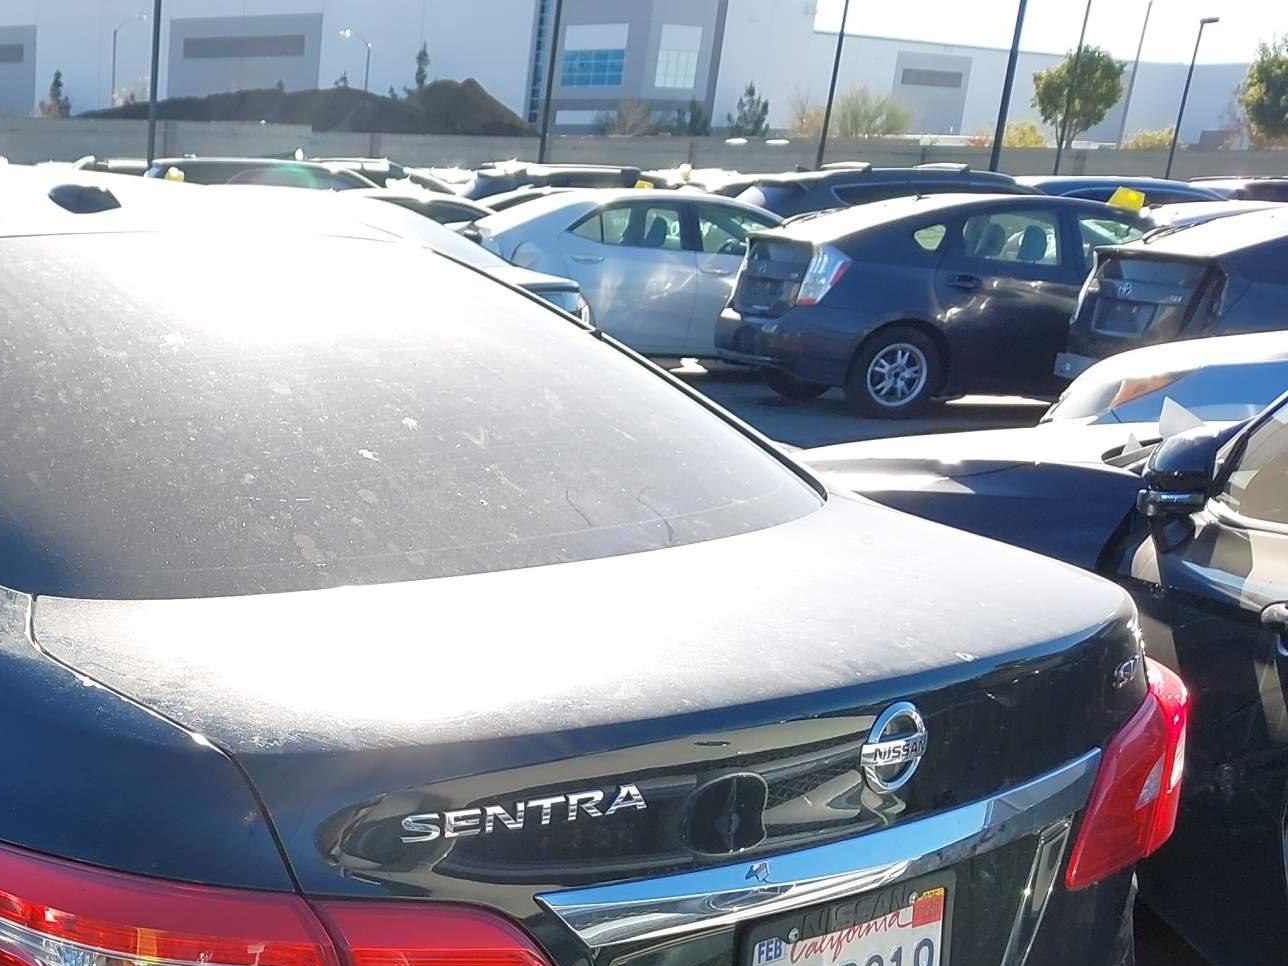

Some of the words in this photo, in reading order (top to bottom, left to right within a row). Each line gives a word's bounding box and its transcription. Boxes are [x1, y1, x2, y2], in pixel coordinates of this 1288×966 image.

[873, 740, 925, 761] NISSAN
[400, 783, 648, 844] SENTRA
[757, 938, 783, 965] FEB
[788, 911, 913, 965] California
